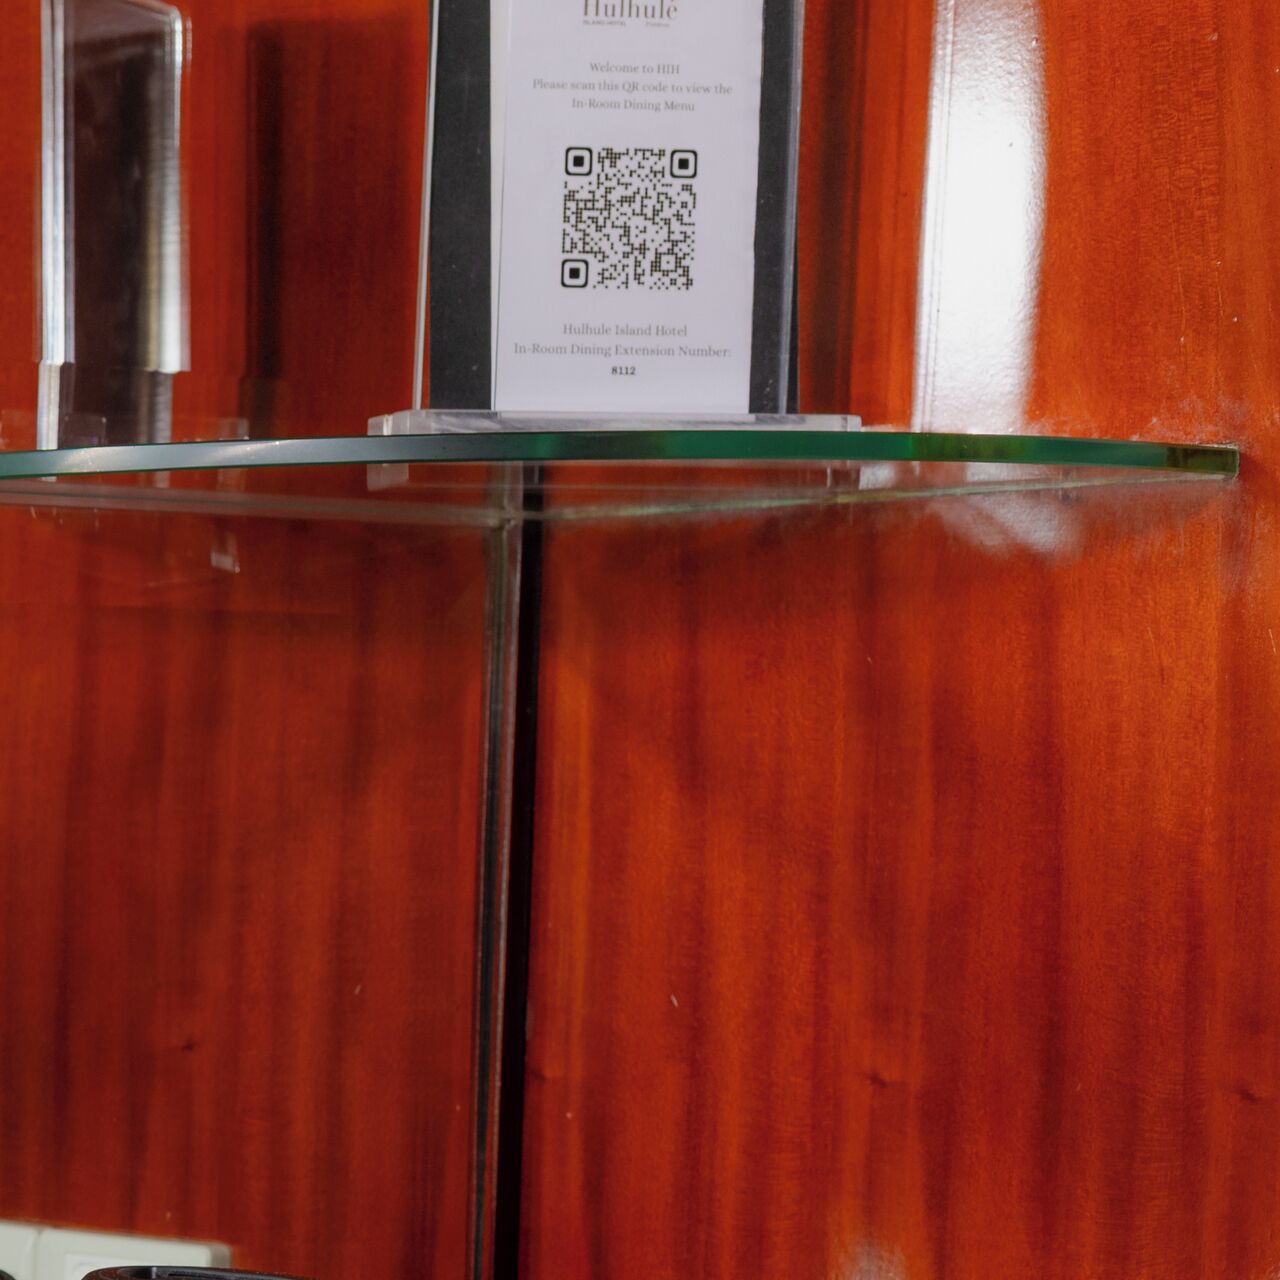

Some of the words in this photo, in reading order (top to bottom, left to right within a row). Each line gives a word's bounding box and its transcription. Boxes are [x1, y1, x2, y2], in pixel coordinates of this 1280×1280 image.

[589, 61, 639, 74] Welcome
[642, 63, 654, 74] to
[532, 78, 568, 90] Please
[570, 81, 596, 91] scan
[598, 80, 619, 91] this
[621, 81, 641, 94] QR
[642, 82, 668, 93] code
[671, 83, 683, 93] to
[686, 83, 711, 94] view
[714, 83, 733, 94] the
[572, 97, 621, 110] In-Room
[623, 99, 661, 112] Dining
[664, 100, 696, 112] Menu
[562, 323, 612, 336] Hulhule
[615, 324, 652, 337] Island
[655, 324, 687, 337] Hotel
[513, 342, 568, 355] In-Room
[570, 343, 612, 358] Dining
[614, 344, 676, 357] Extension
[678, 345, 732, 358] Number:
[611, 366, 636, 376] 8112
